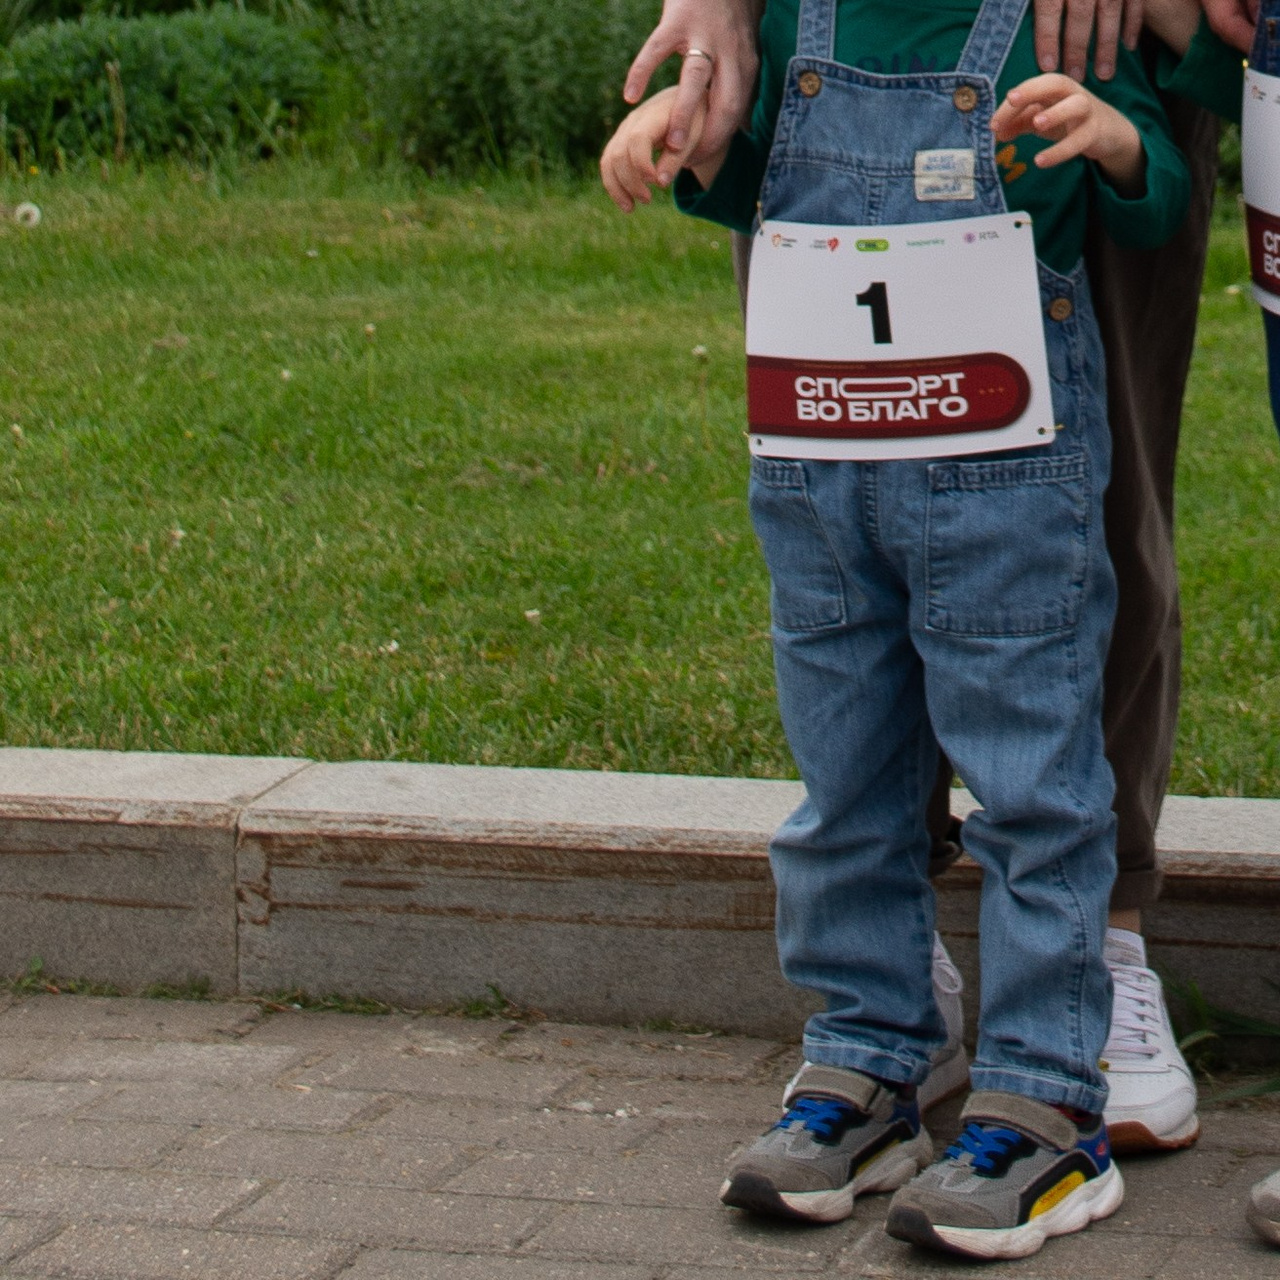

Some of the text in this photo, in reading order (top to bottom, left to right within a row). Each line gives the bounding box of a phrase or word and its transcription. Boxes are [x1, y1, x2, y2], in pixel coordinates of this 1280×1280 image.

[856, 281, 893, 344] 1
[794, 372, 966, 400] СПОРТ
[796, 396, 969, 422] ВО БЛАГО
